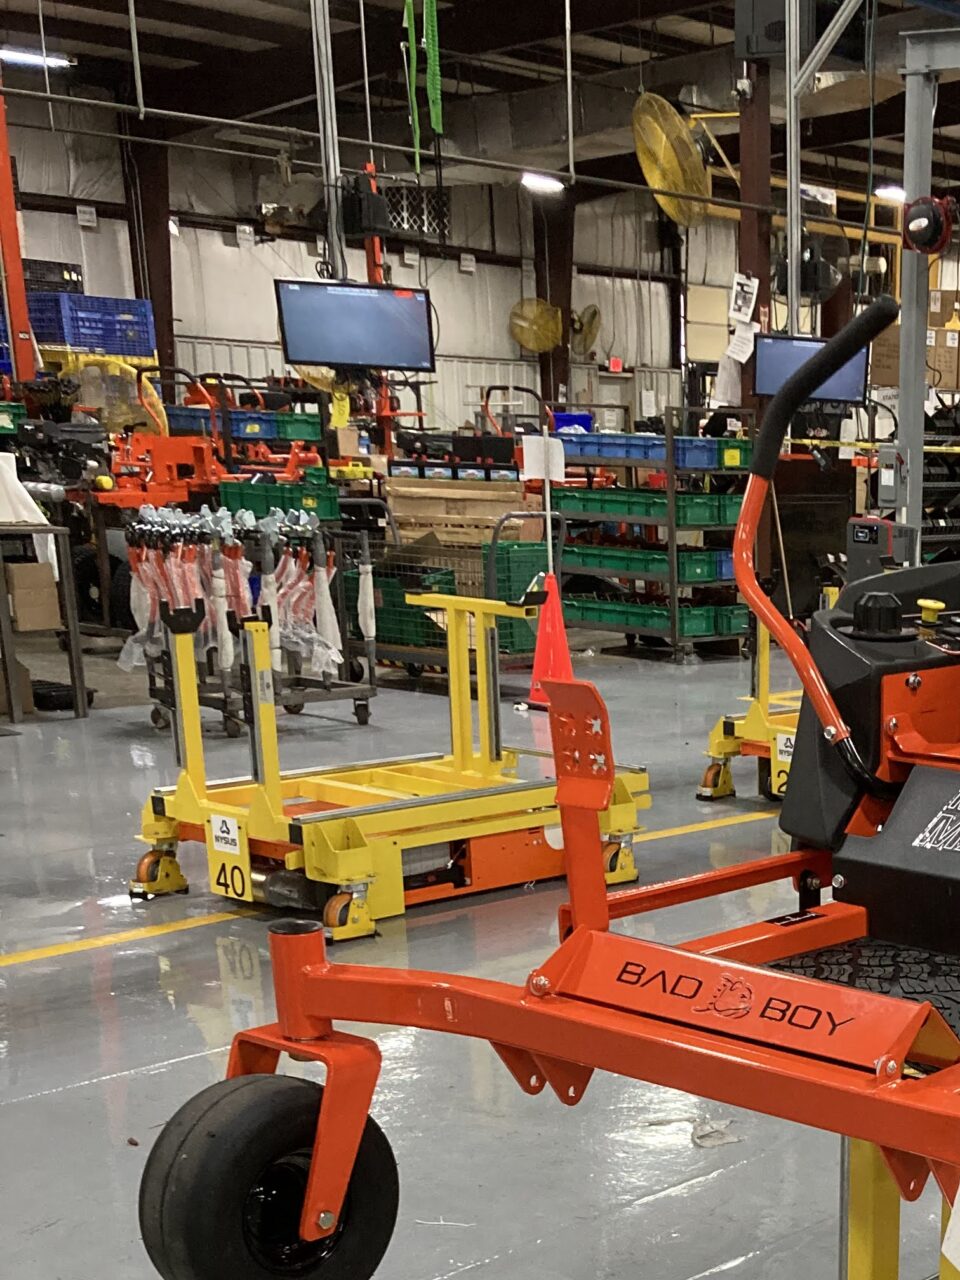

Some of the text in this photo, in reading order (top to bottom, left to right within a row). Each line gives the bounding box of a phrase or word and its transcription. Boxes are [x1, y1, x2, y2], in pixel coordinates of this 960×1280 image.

[214, 834, 238, 847] NYSUS
[215, 862, 246, 898] 40
[615, 960, 856, 1037] BAD BOY
